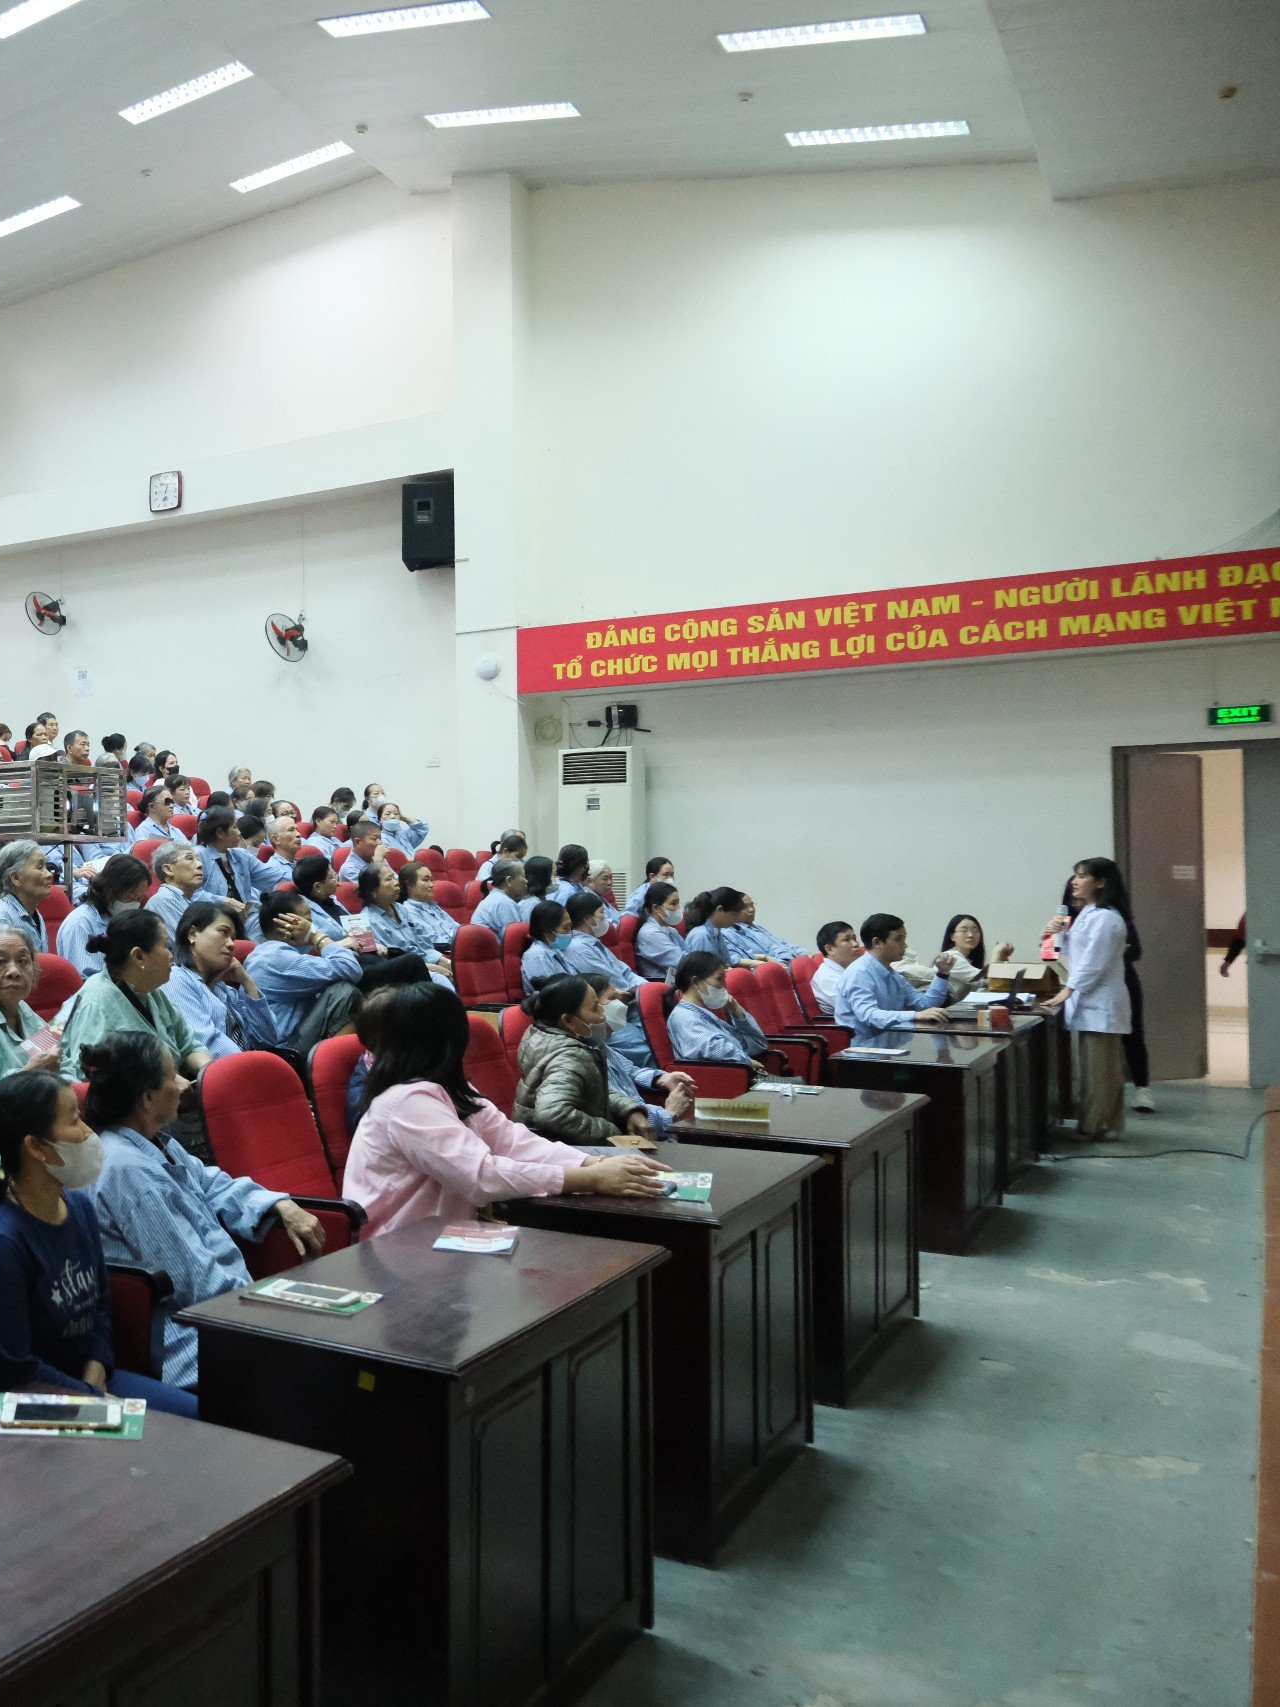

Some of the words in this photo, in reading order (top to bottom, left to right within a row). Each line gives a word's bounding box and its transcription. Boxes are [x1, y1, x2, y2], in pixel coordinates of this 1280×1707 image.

[552, 654, 583, 680] TỔ
[590, 654, 658, 677] CHỨC
[667, 649, 718, 672] MỌI
[725, 638, 821, 665] THẮNG
[830, 633, 876, 659] LỢI
[885, 624, 949, 652] CỦA
[959, 619, 1048, 646] CÁCH
[1058, 608, 1167, 638] MẠNG
[1176, 597, 1258, 627] VIỆT
[585, 624, 656, 649] ĐẢNG
[664, 618, 738, 643] CỘNG
[747, 608, 806, 634] SẢN
[815, 601, 877, 628] VIỆT
[886, 594, 961, 620] NAM
[994, 576, 1099, 609] NGƯỜI
[1110, 569, 1207, 598] LÃNH
[1217, 706, 1261, 717] EXIT
